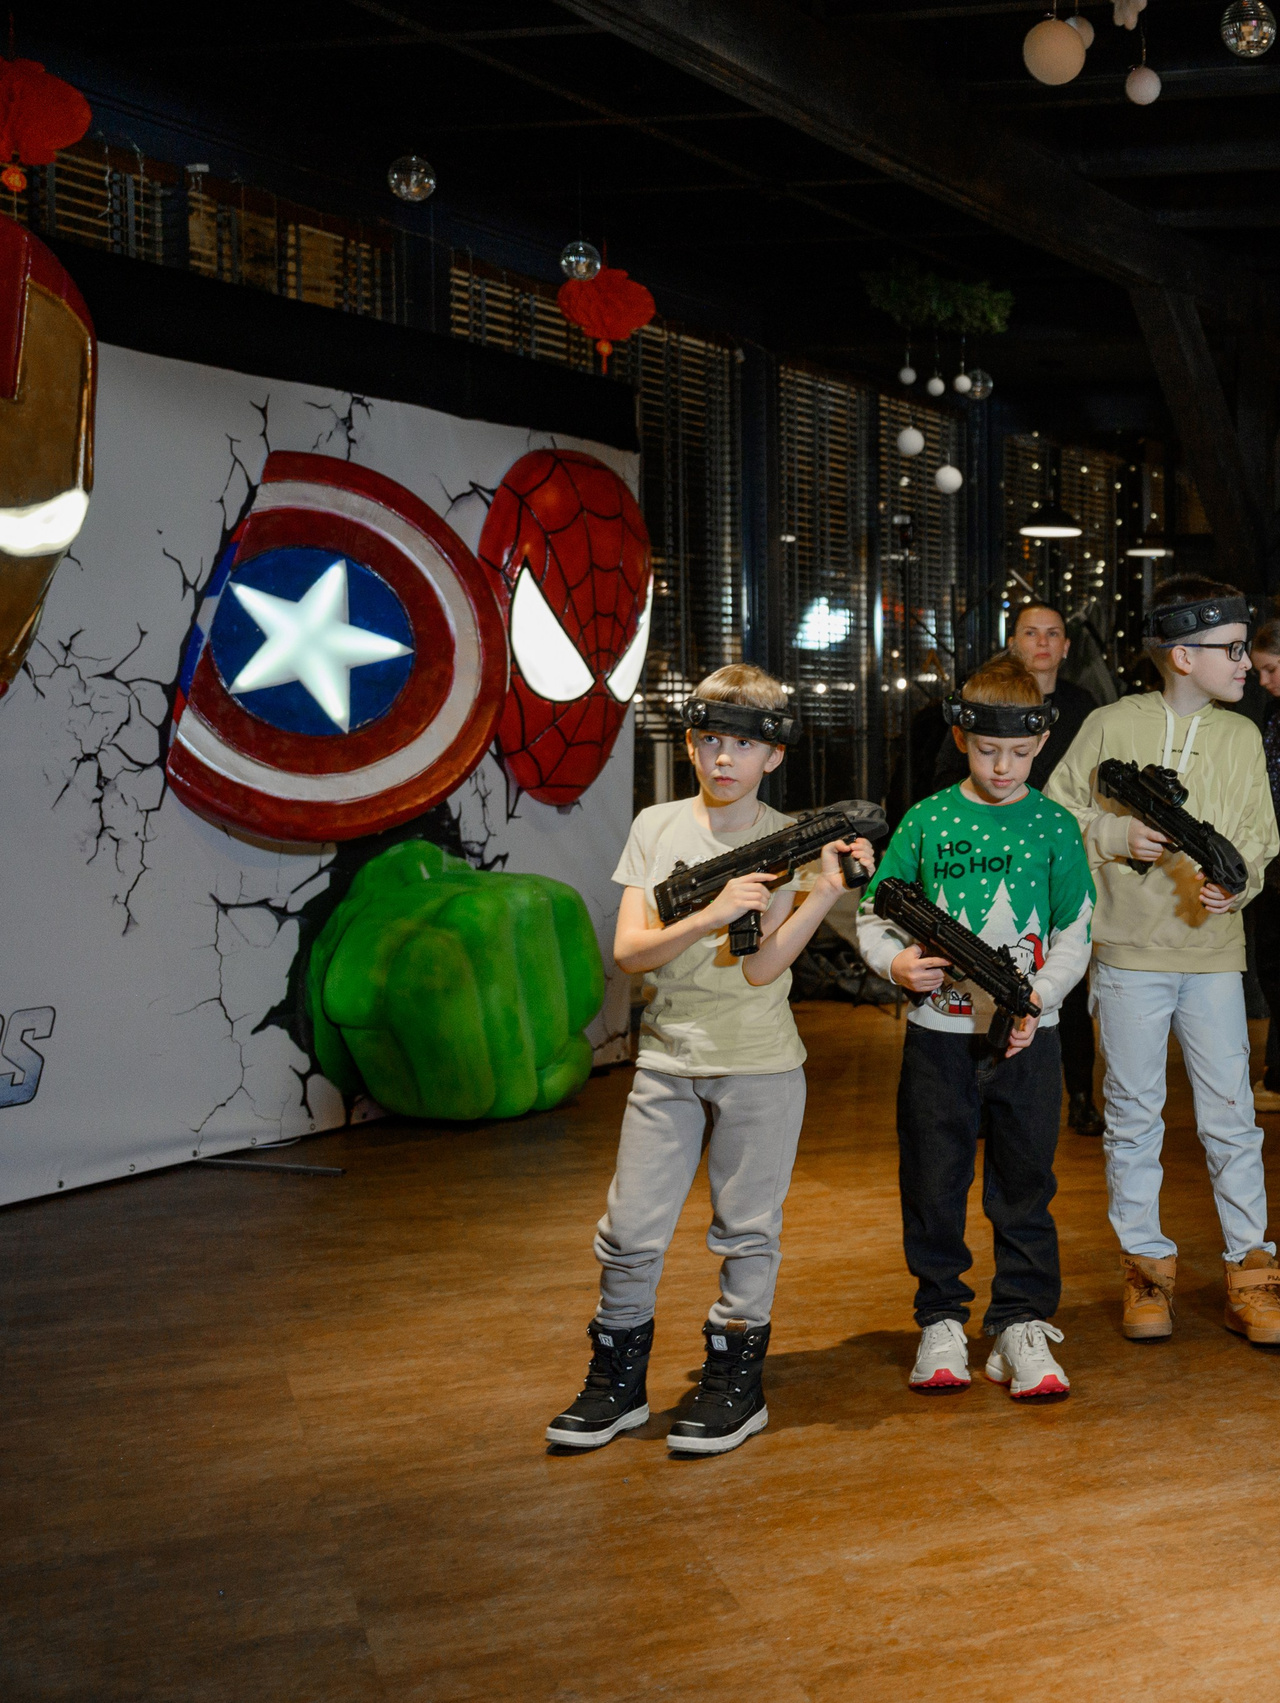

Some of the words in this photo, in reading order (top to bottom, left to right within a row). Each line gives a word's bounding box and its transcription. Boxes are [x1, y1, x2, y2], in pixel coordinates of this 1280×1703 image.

[937, 840, 972, 860] HO
[934, 861, 966, 879] HO
[970, 854, 1013, 875] HO!
[0, 1005, 56, 1109] S
